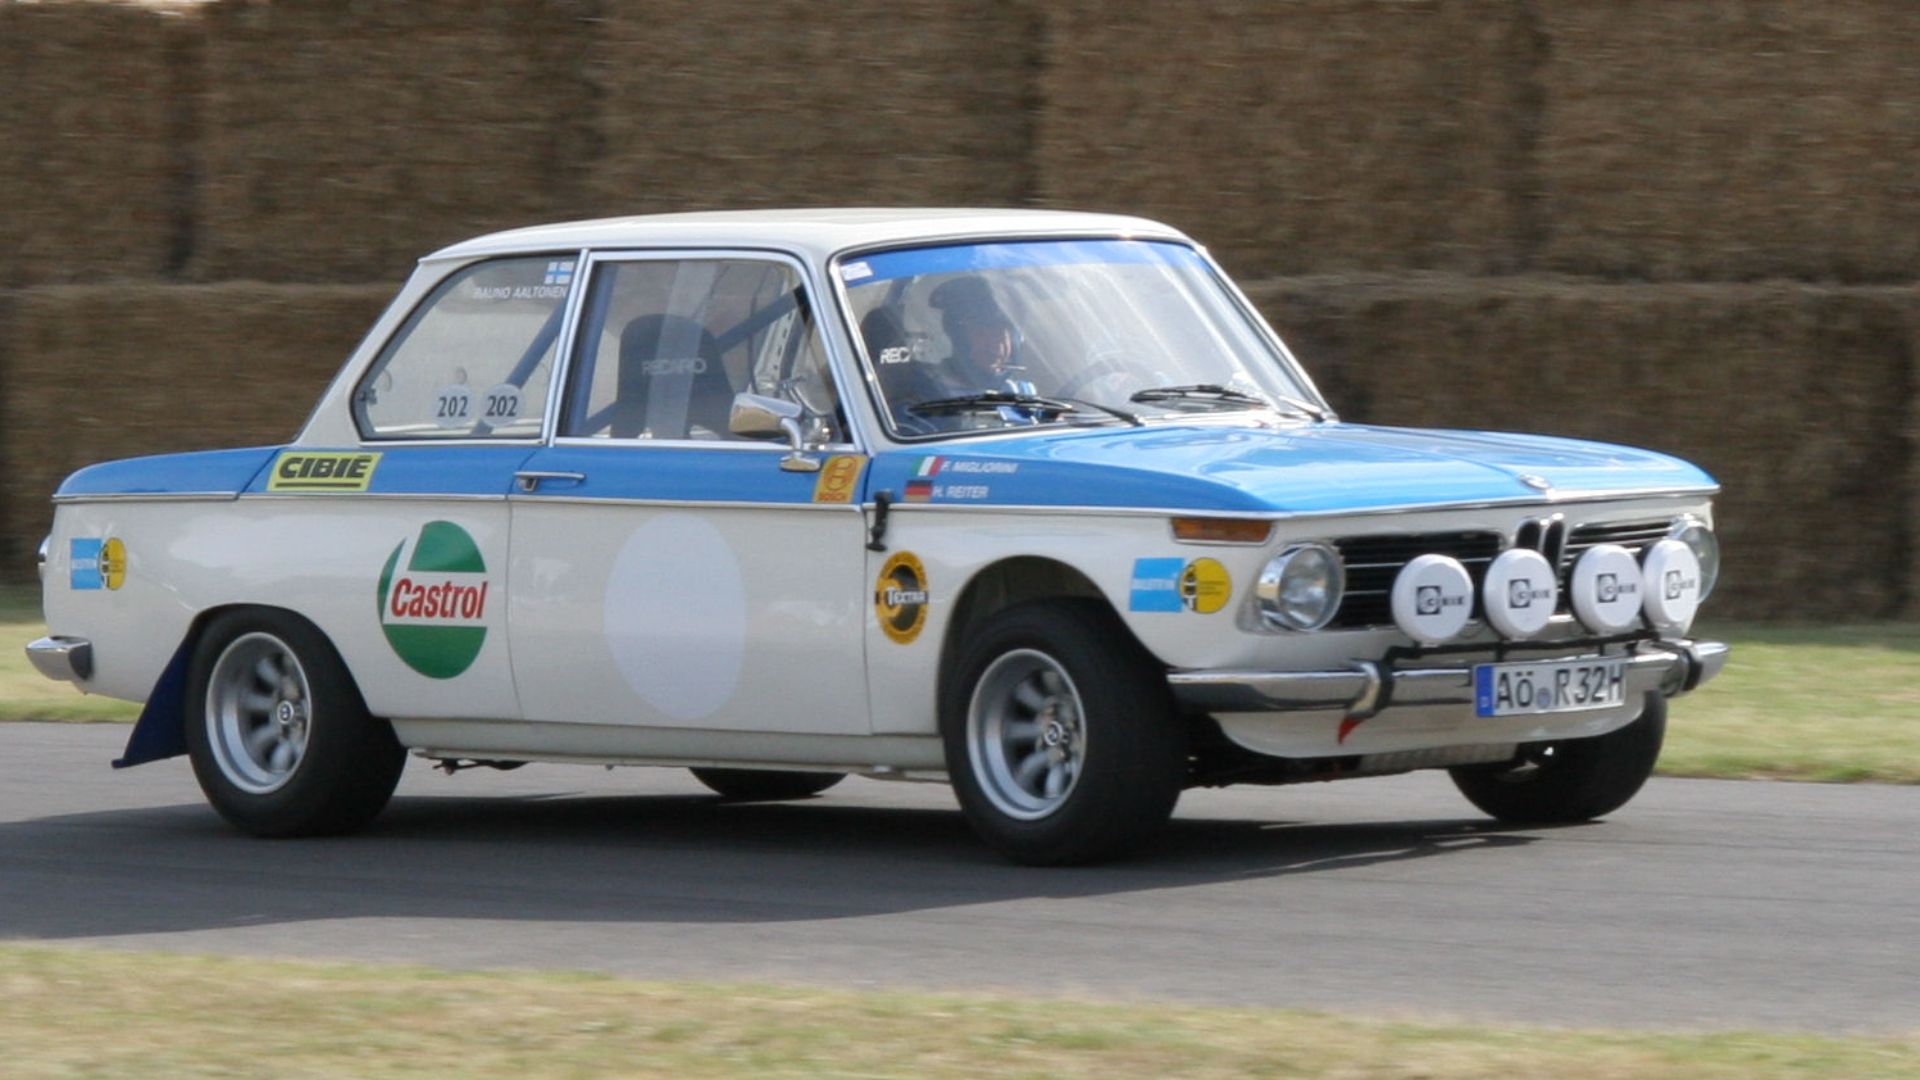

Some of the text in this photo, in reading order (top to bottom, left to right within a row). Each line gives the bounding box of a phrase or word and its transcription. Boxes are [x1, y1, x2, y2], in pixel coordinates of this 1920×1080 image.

[437, 396, 469, 418] 202
[486, 395, 519, 418] 202
[946, 485, 990, 499] REITER
[391, 578, 488, 619] Castrol
[1496, 671, 1535, 709] AÖ
